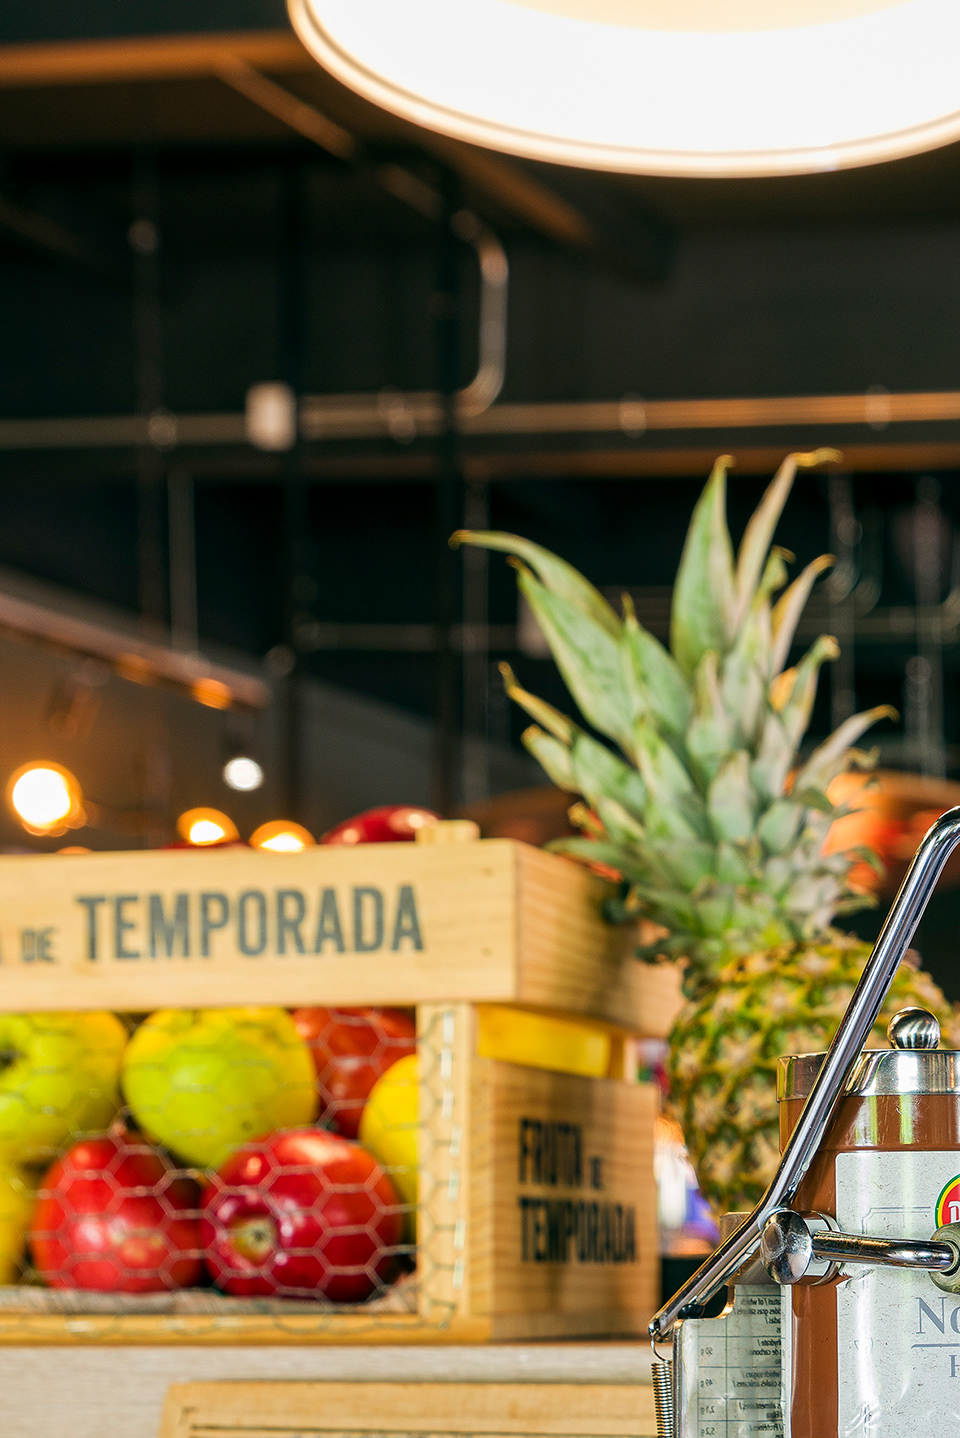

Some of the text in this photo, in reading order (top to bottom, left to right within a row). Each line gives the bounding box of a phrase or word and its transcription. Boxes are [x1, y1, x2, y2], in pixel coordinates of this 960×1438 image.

[20, 884, 424, 963] DE TEMPORADA
[519, 1196, 638, 1265] TEMPORADA
